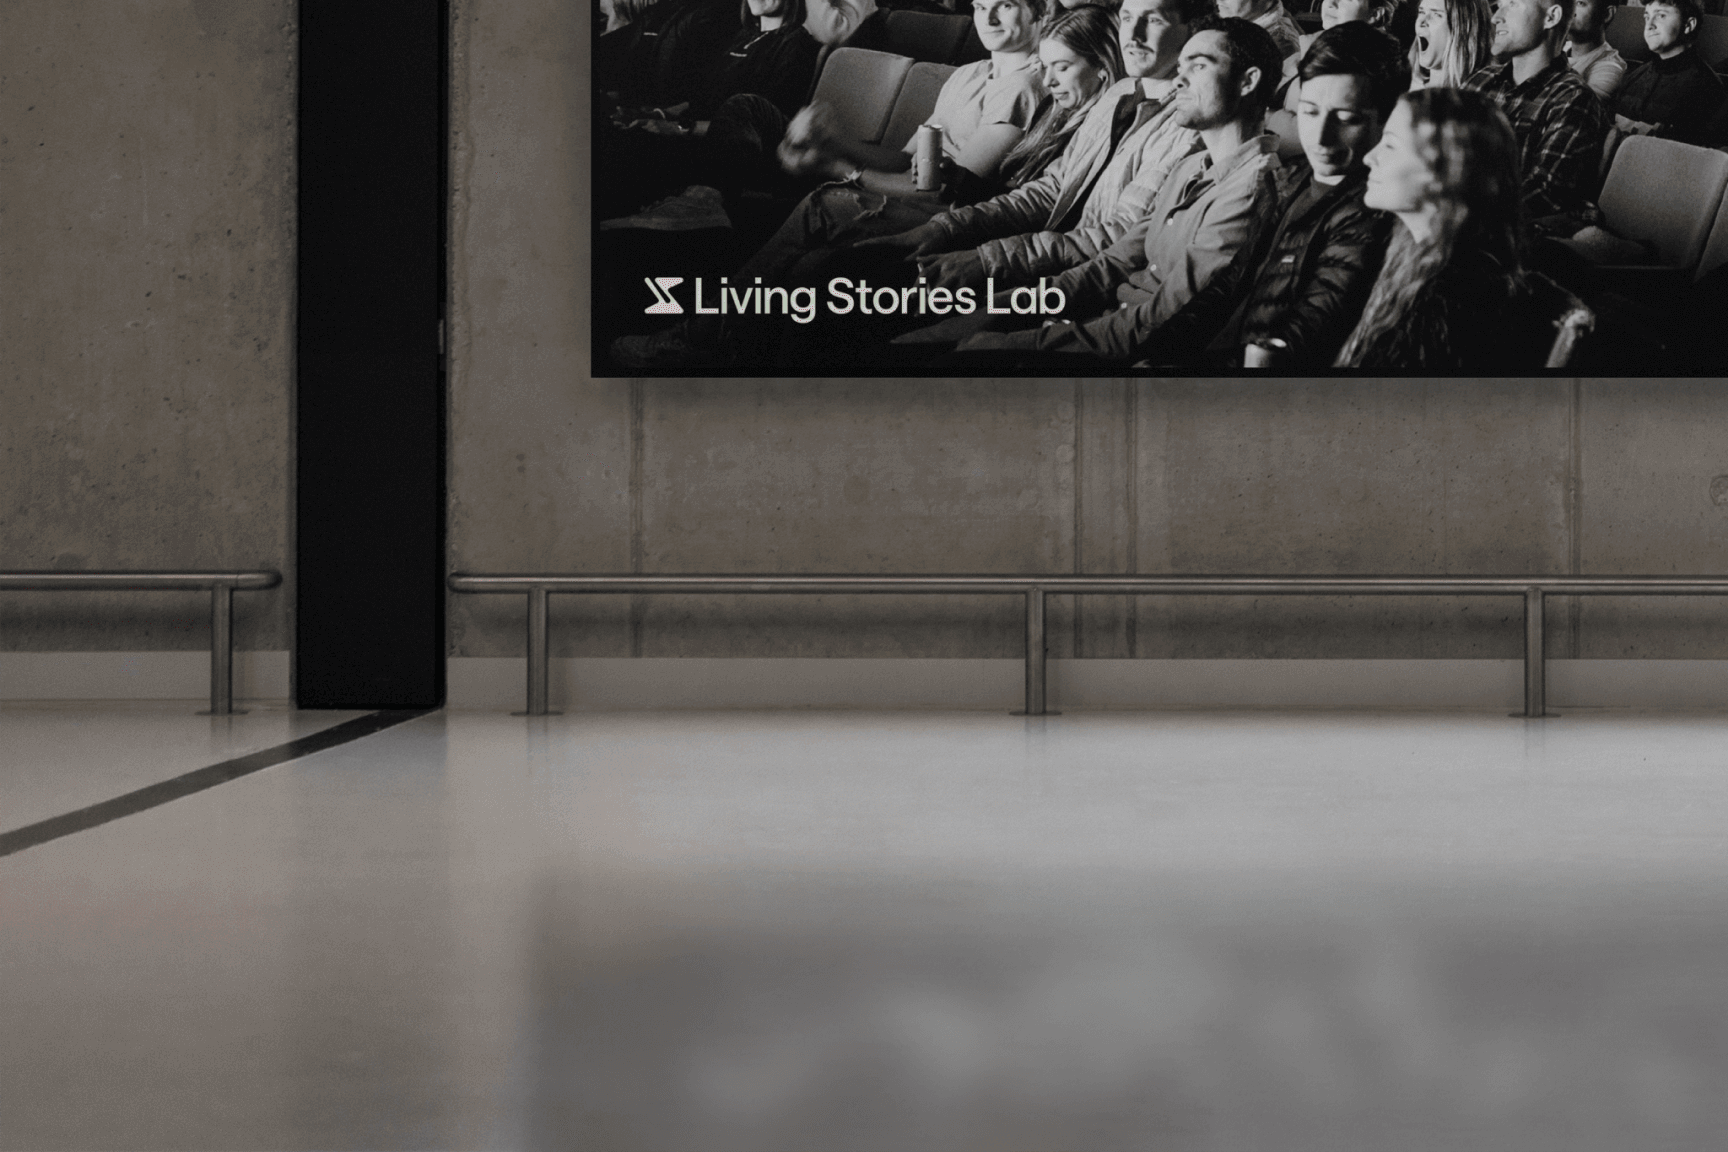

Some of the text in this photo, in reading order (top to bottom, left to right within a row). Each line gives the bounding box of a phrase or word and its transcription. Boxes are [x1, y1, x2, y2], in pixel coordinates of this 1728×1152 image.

[694, 276, 1067, 324] Living Stories Lab
